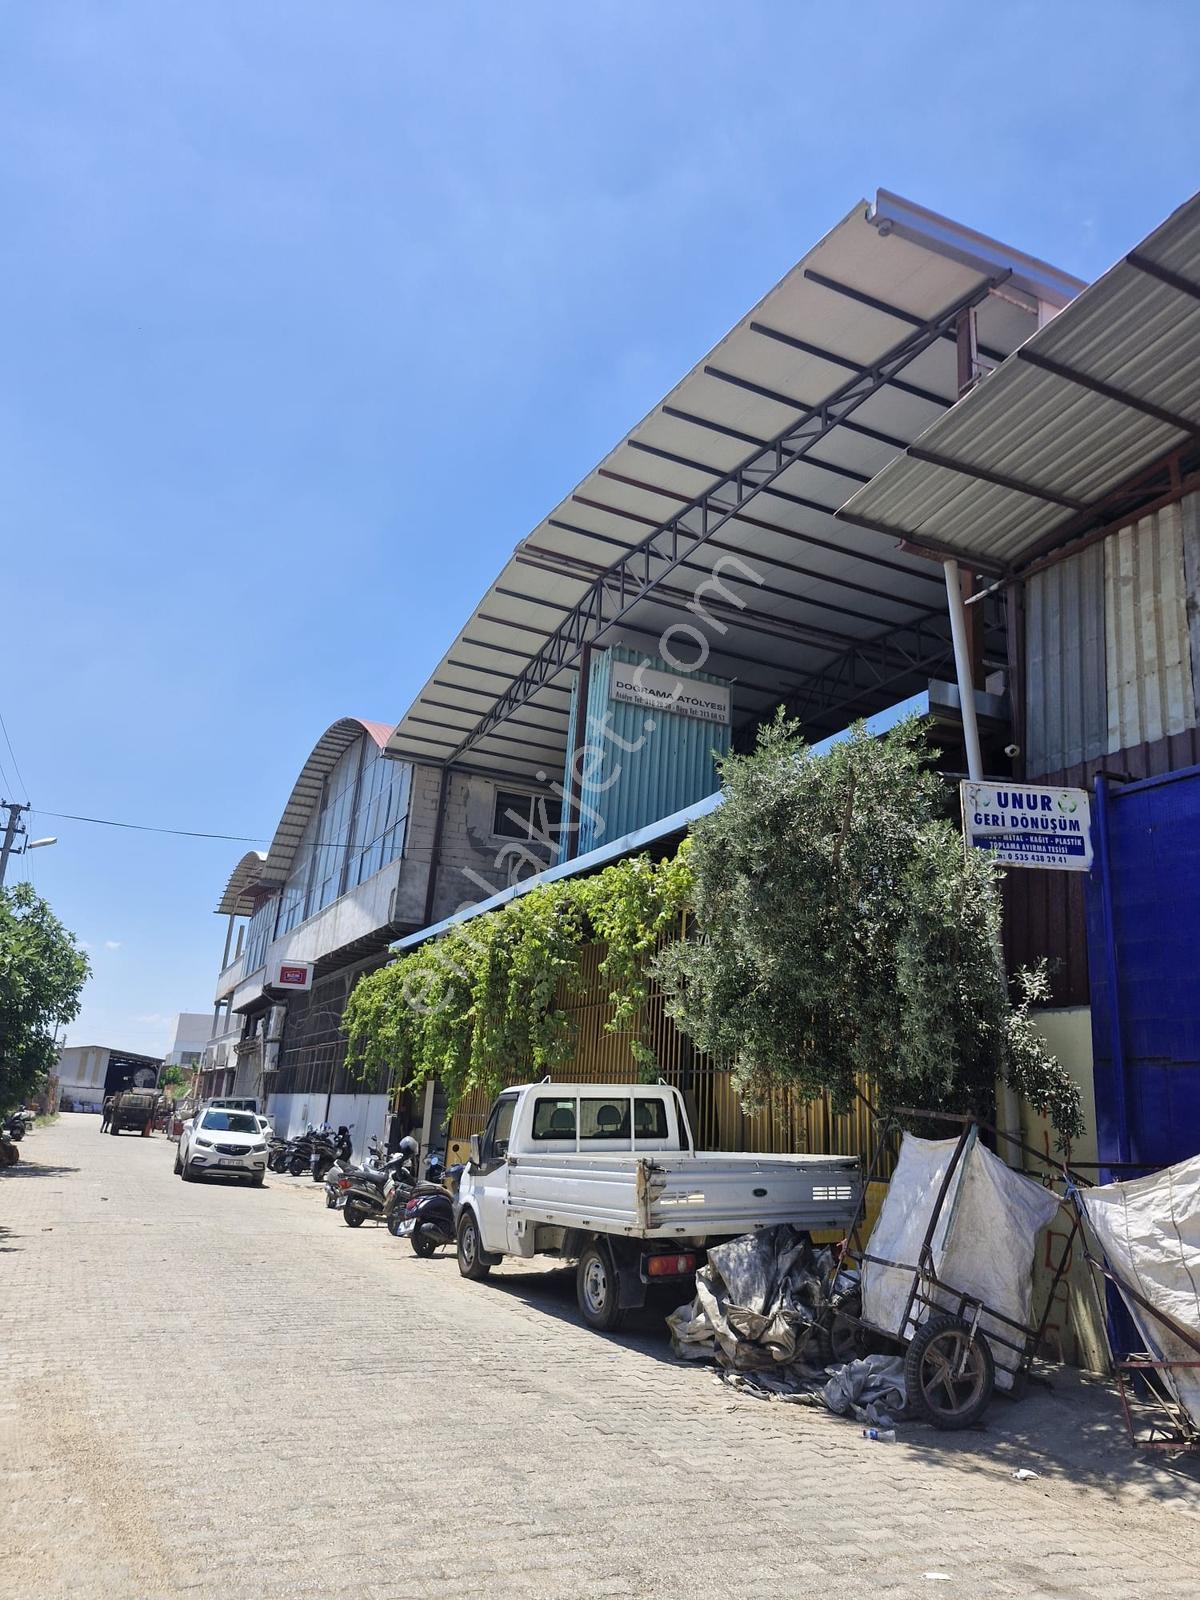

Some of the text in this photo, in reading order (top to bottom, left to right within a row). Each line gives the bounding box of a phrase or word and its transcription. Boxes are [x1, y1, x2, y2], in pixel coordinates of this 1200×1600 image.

[996, 792, 1053, 811] UNUR
[974, 811, 1081, 834] GERİ DÖNÜŞÜM
[989, 841, 1068, 854] TOPLAMA AYIRMA TESİSİ
[1055, 837, 1082, 846] PLASTİK
